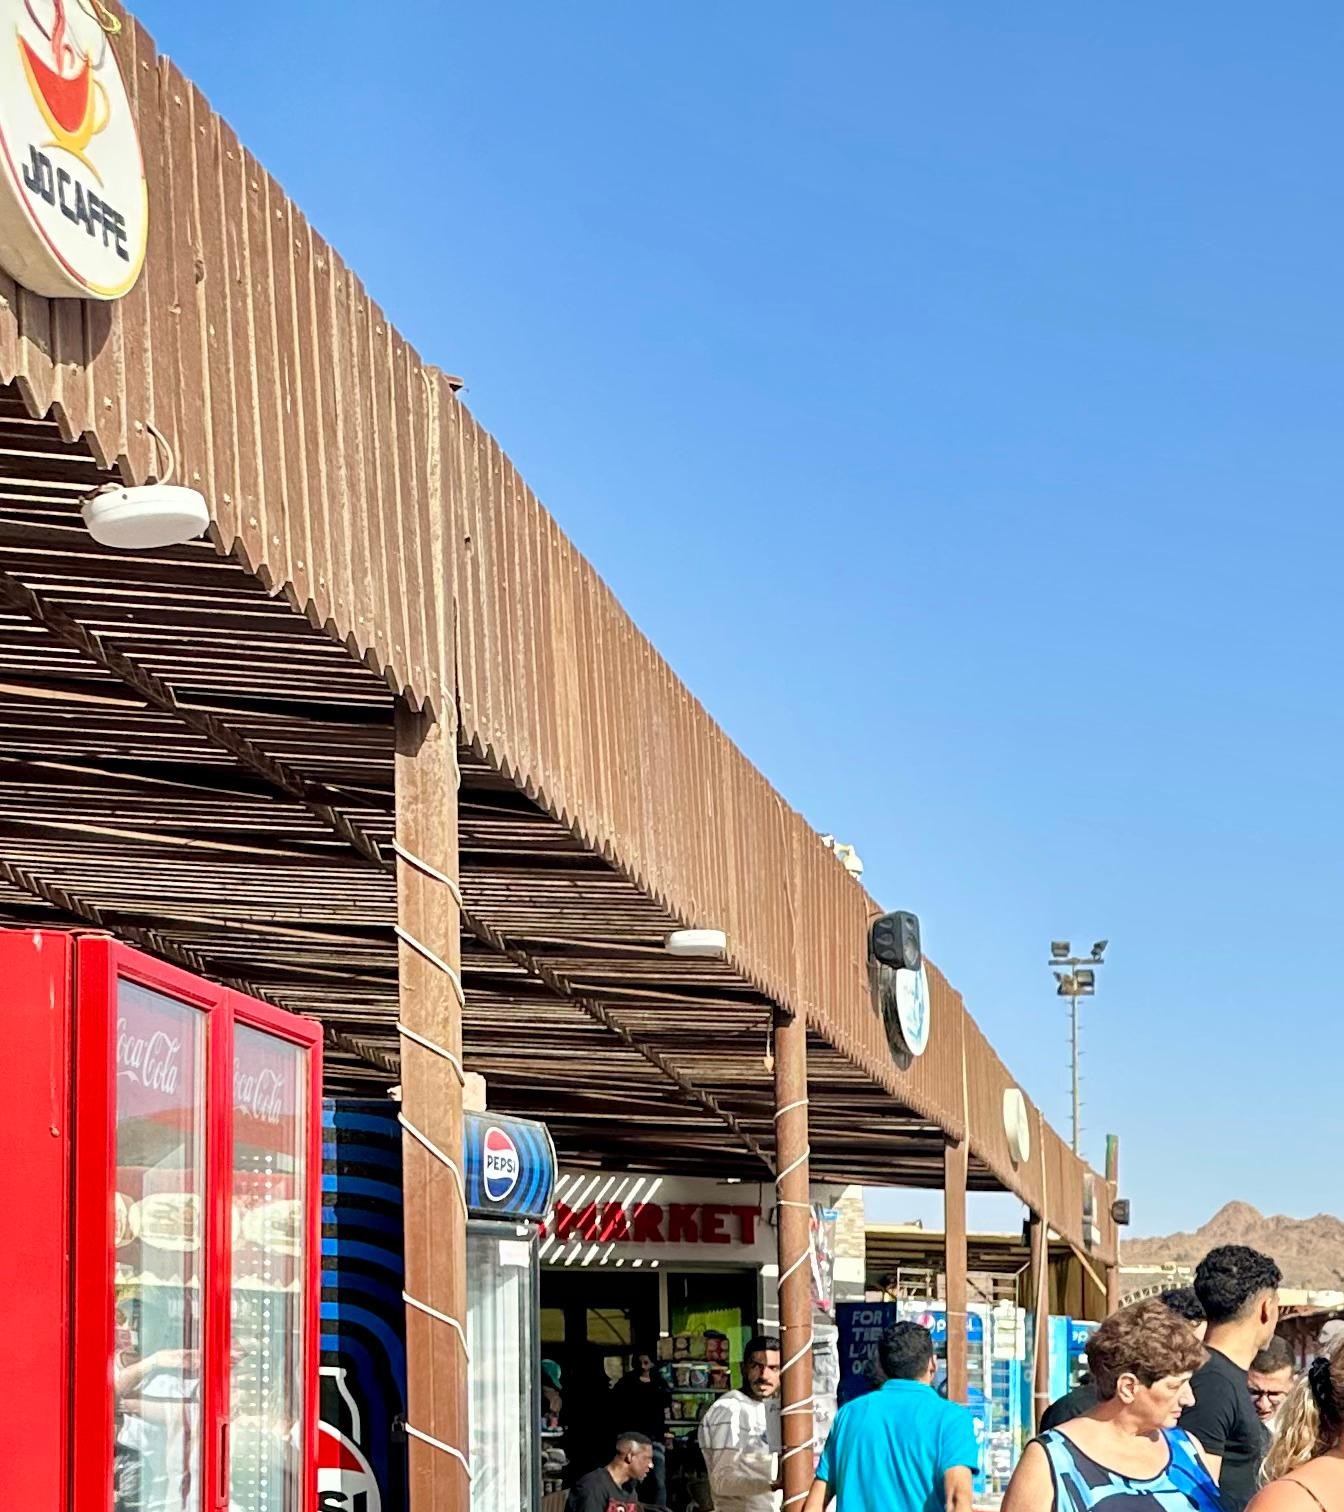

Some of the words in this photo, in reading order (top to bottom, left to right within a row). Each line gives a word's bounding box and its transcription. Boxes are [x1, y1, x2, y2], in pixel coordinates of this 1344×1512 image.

[56, 167, 130, 263] CAFFE
[487, 1154, 516, 1174] PEPSI
[556, 1199, 761, 1245] MARKET
[851, 1310, 883, 1326] FOR
